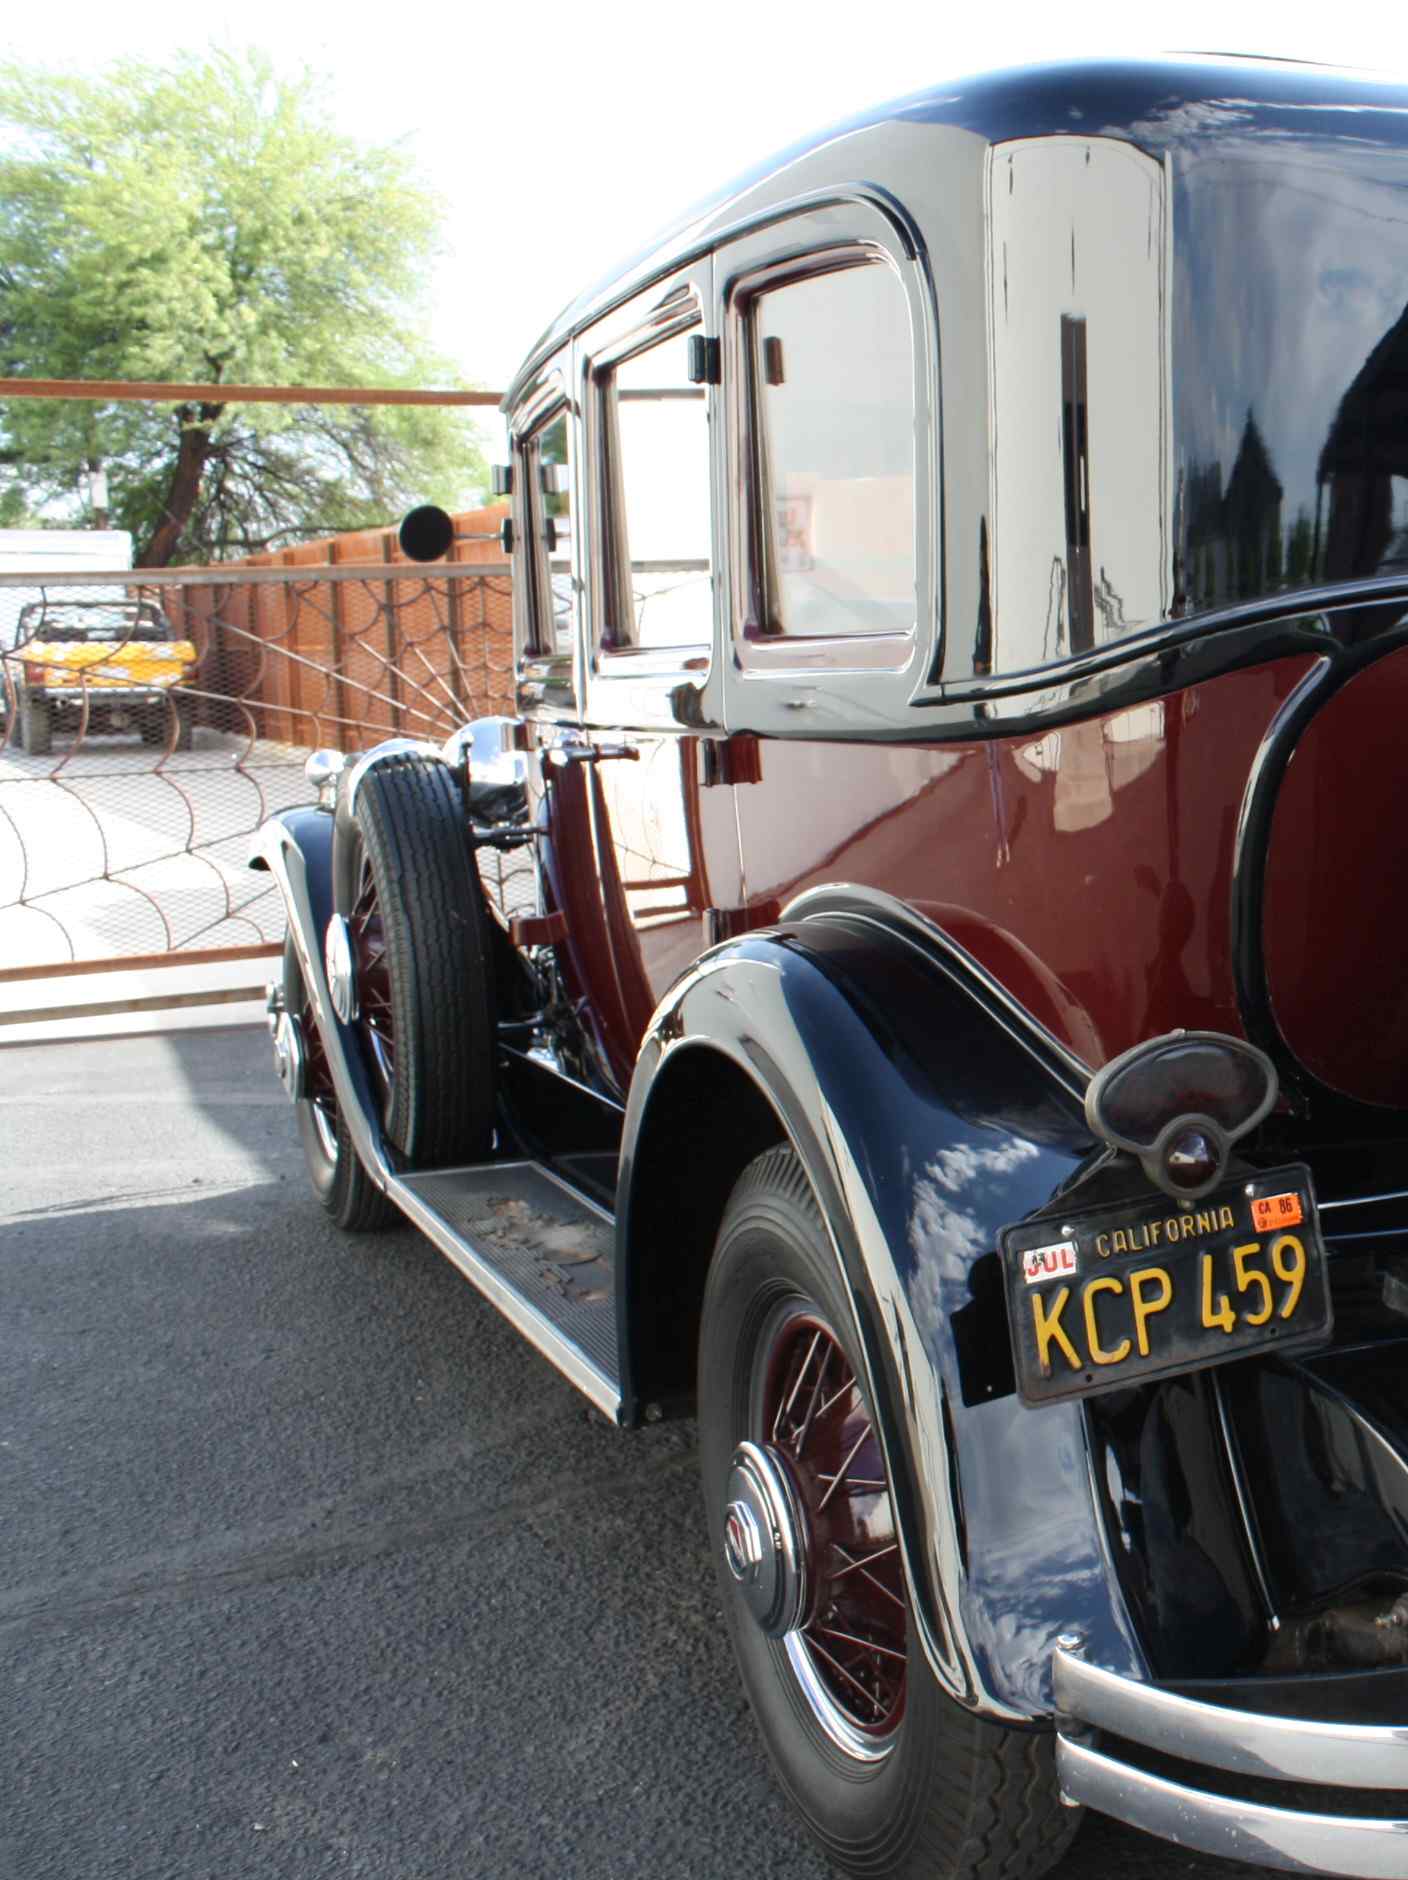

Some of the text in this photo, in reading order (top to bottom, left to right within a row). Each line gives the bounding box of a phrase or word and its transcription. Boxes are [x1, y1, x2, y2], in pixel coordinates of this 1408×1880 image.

[1258, 1201, 1271, 1215] CA
[1095, 1206, 1234, 1258] CALIFORNIA
[1027, 1249, 1073, 1277] JUL
[1031, 1234, 1306, 1377] KCP 459
